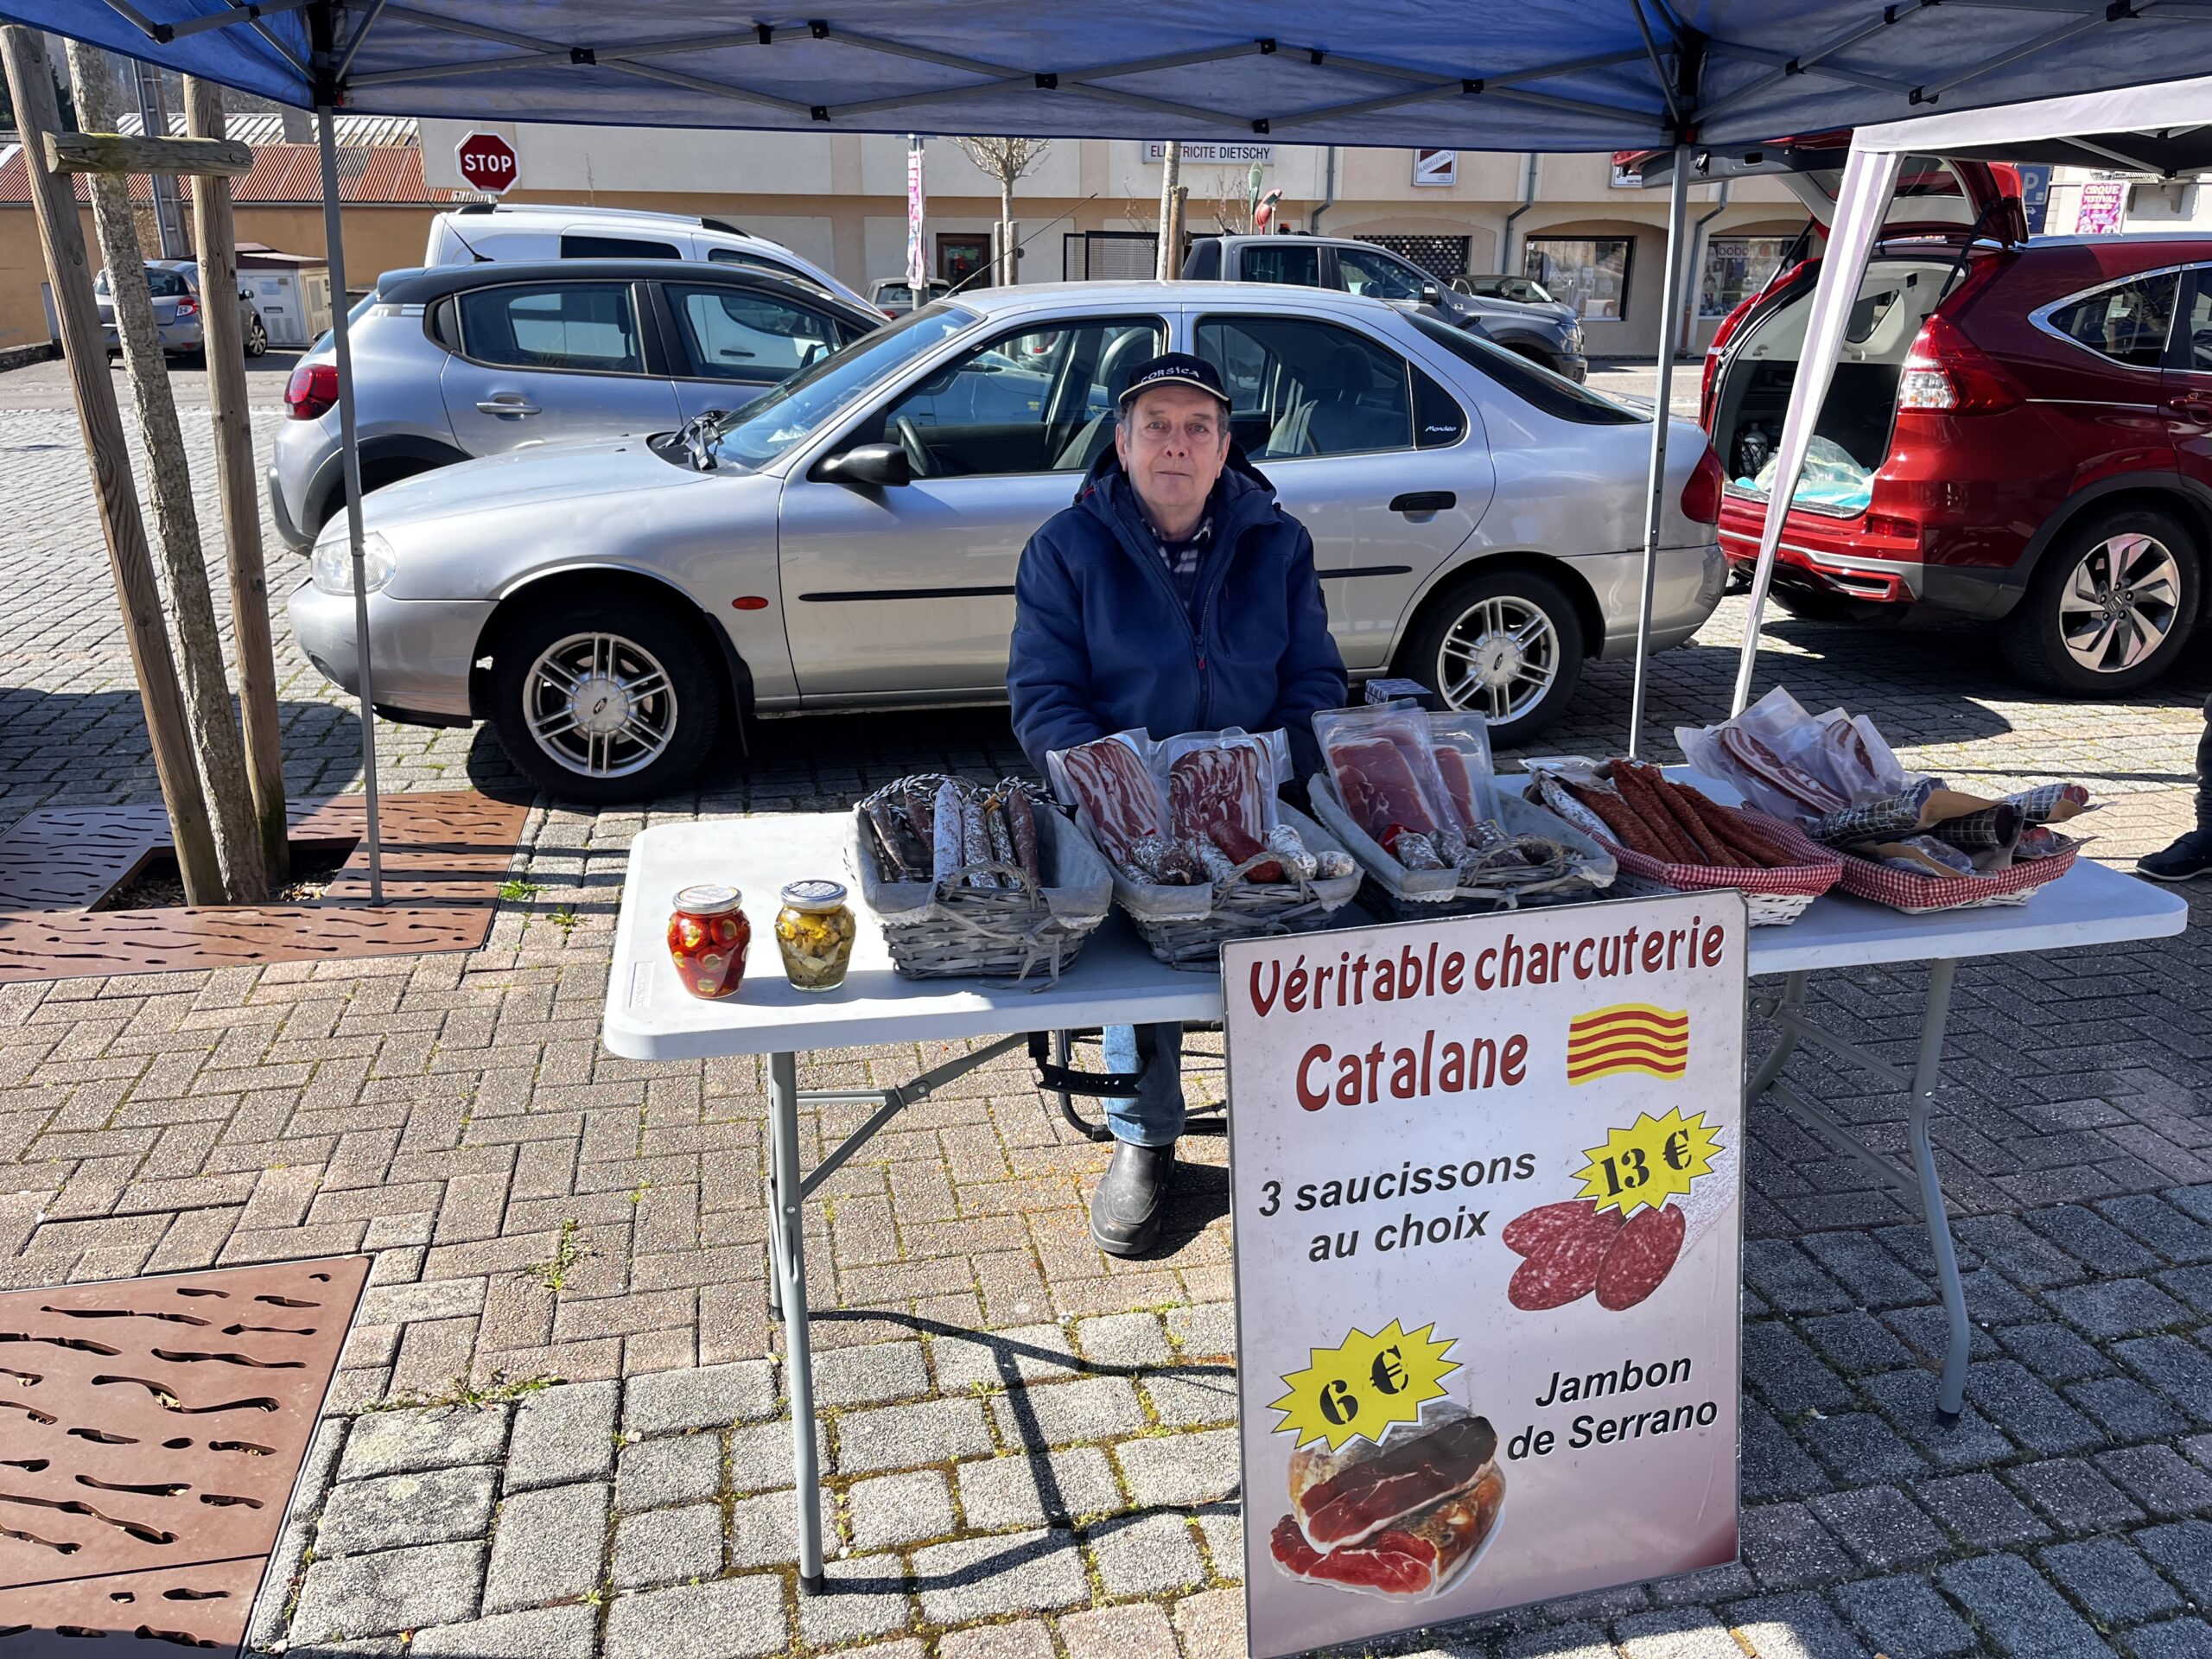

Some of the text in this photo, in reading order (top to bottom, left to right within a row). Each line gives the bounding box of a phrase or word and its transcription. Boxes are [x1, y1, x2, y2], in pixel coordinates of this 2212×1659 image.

[464, 153, 512, 173] STOP
[1150, 144, 1270, 160] ELRICITE DIETSCHY
[2082, 195, 2117, 204] FESTIVAL
[2084, 185, 2120, 195] CIRQUE
[1249, 916, 1725, 1017] Véritable charcuterie
[1296, 1029, 1529, 1112] Catalane
[1258, 1152, 1537, 1217] 3 saucissons
[1600, 1129, 1694, 1198] 13 €
[1308, 1205, 1491, 1263] au choix
[1319, 1344, 1410, 1427] 6 €
[1535, 1357, 1693, 1408] Jambon
[1506, 1401, 1719, 1461] de Serrano
